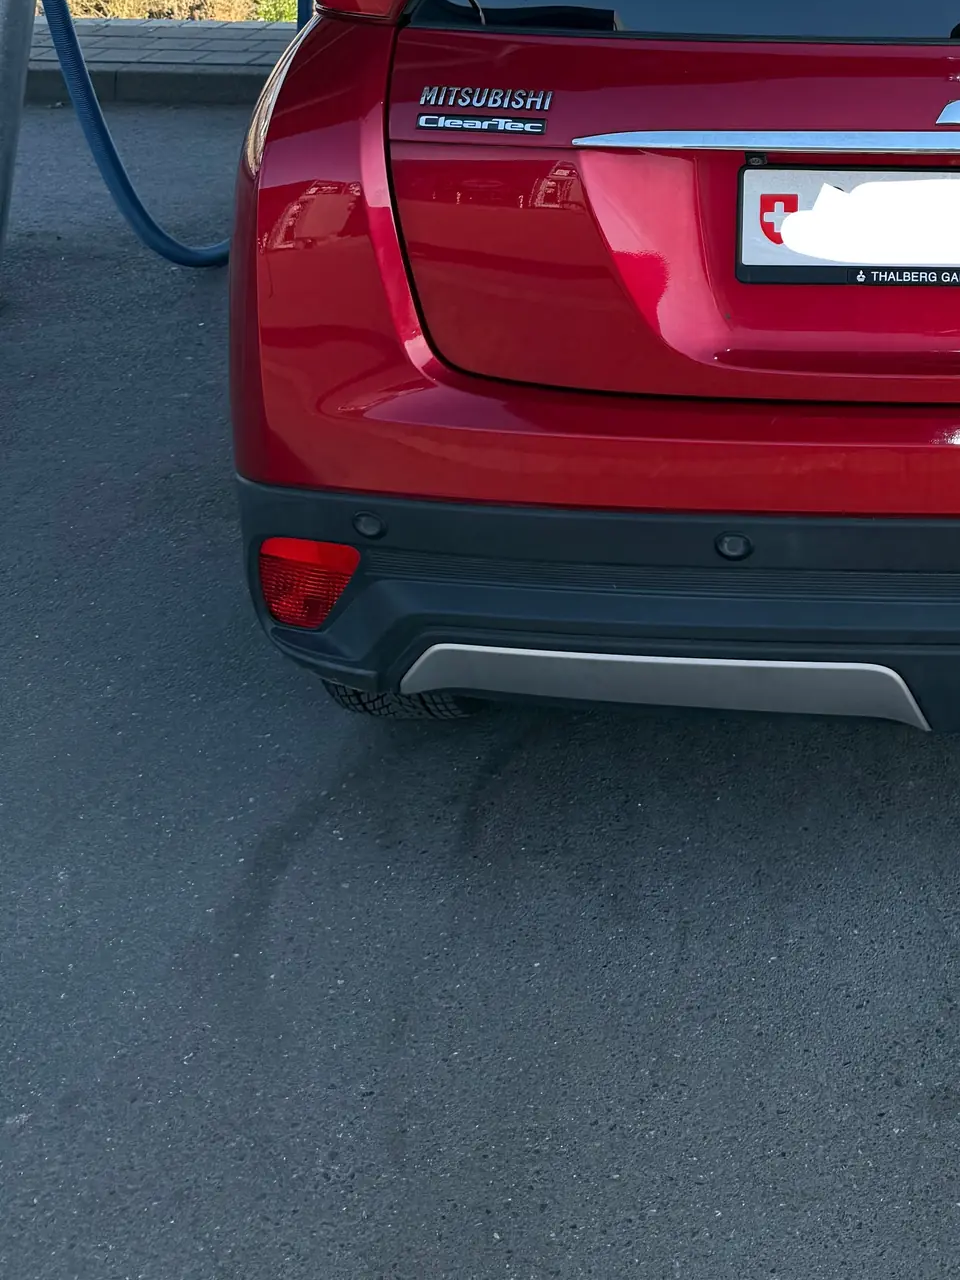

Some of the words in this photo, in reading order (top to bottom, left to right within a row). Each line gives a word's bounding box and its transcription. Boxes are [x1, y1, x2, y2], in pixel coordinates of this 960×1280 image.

[418, 86, 554, 111] MITSUBISHI
[418, 115, 543, 132] ClearTec
[871, 271, 938, 283] THALBERG
